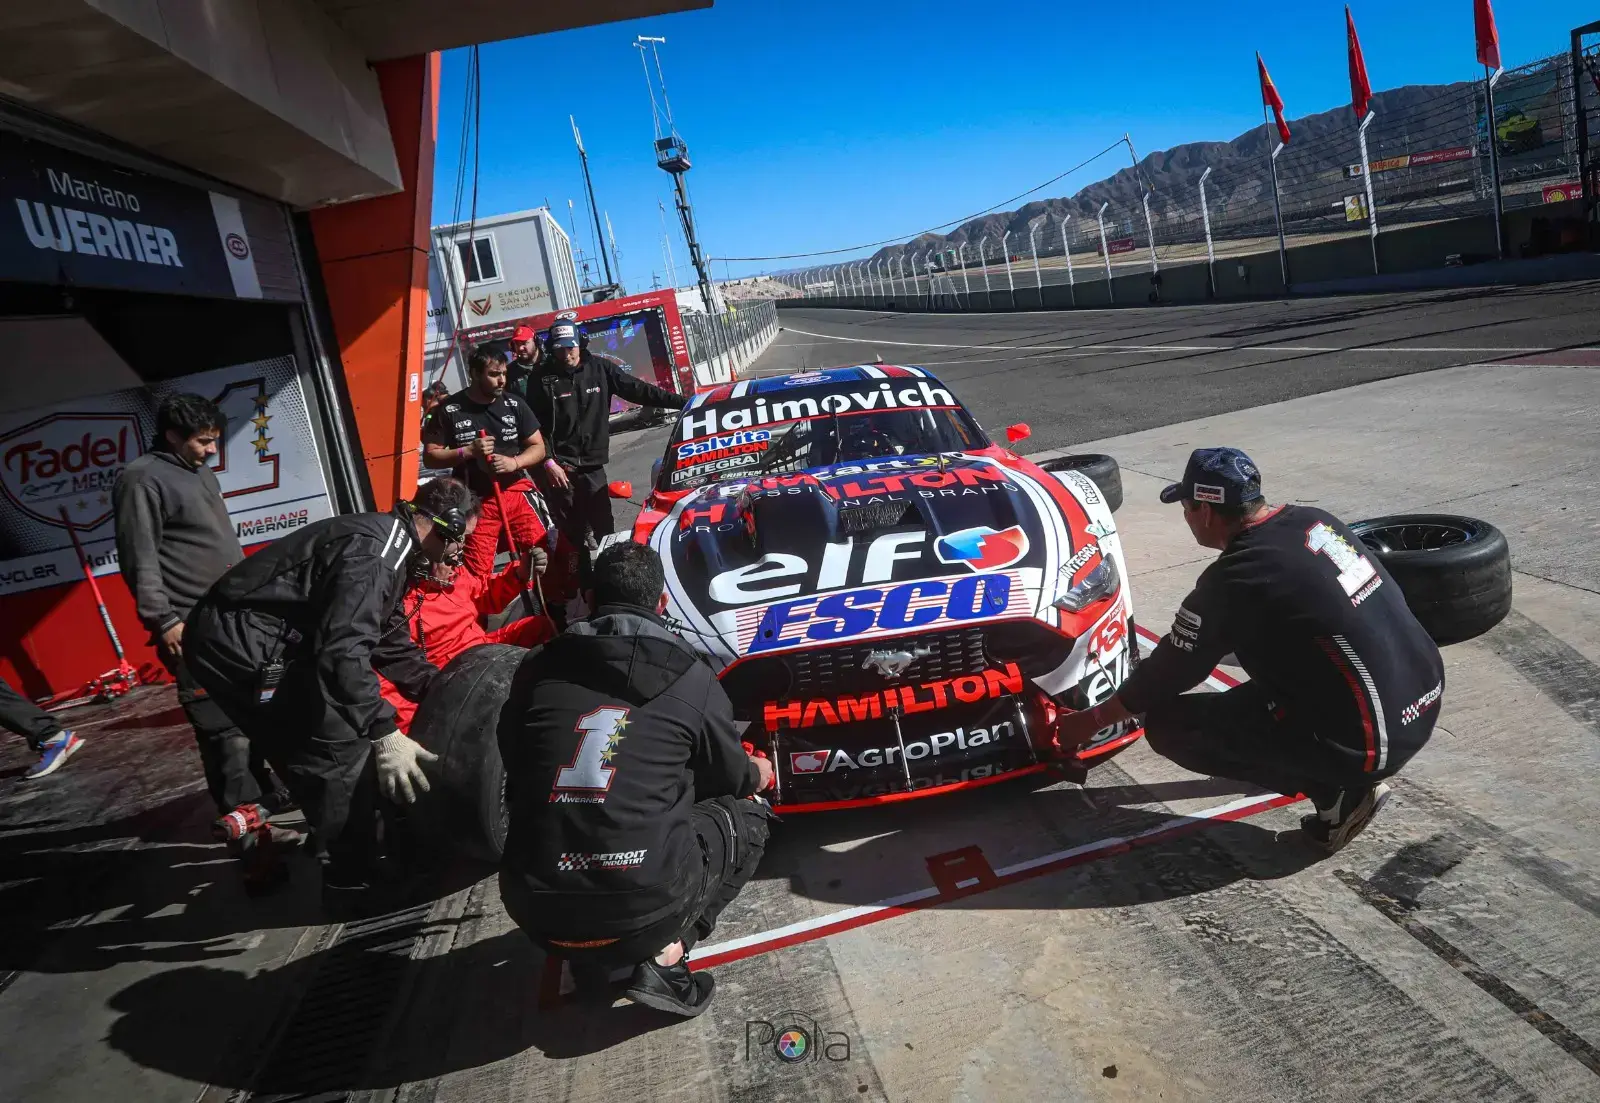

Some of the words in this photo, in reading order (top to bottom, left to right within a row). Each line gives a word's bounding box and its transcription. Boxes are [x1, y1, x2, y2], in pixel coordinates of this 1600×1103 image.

[1368, 158, 1400, 169] MERICA
[47, 168, 141, 213] Mariano
[16, 198, 184, 268] WERNER
[498, 286, 541, 298] CIRCUITO
[500, 297, 520, 306] SAN
[523, 290, 551, 302] JUAN
[427, 307, 449, 318] uan
[682, 381, 956, 441] Haimovich
[5, 426, 129, 484] Fadel
[676, 441, 768, 469] HAMILTON
[678, 430, 772, 460] Salvita
[674, 455, 757, 482] INTEGRA
[242, 509, 309, 528] MARIANO
[242, 517, 309, 537] WERNER
[708, 531, 926, 604] elf
[1058, 543, 1100, 579] INTEGRA
[1304, 520, 1377, 597] 1
[748, 573, 1010, 655] ESCO
[763, 662, 1024, 732] HAMILTON
[552, 705, 630, 792] 1
[827, 719, 1014, 772] AgroPlan
[567, 796, 606, 804] WERNER
[591, 849, 648, 861] DETROIT
[602, 857, 645, 867] INDUSTRY
